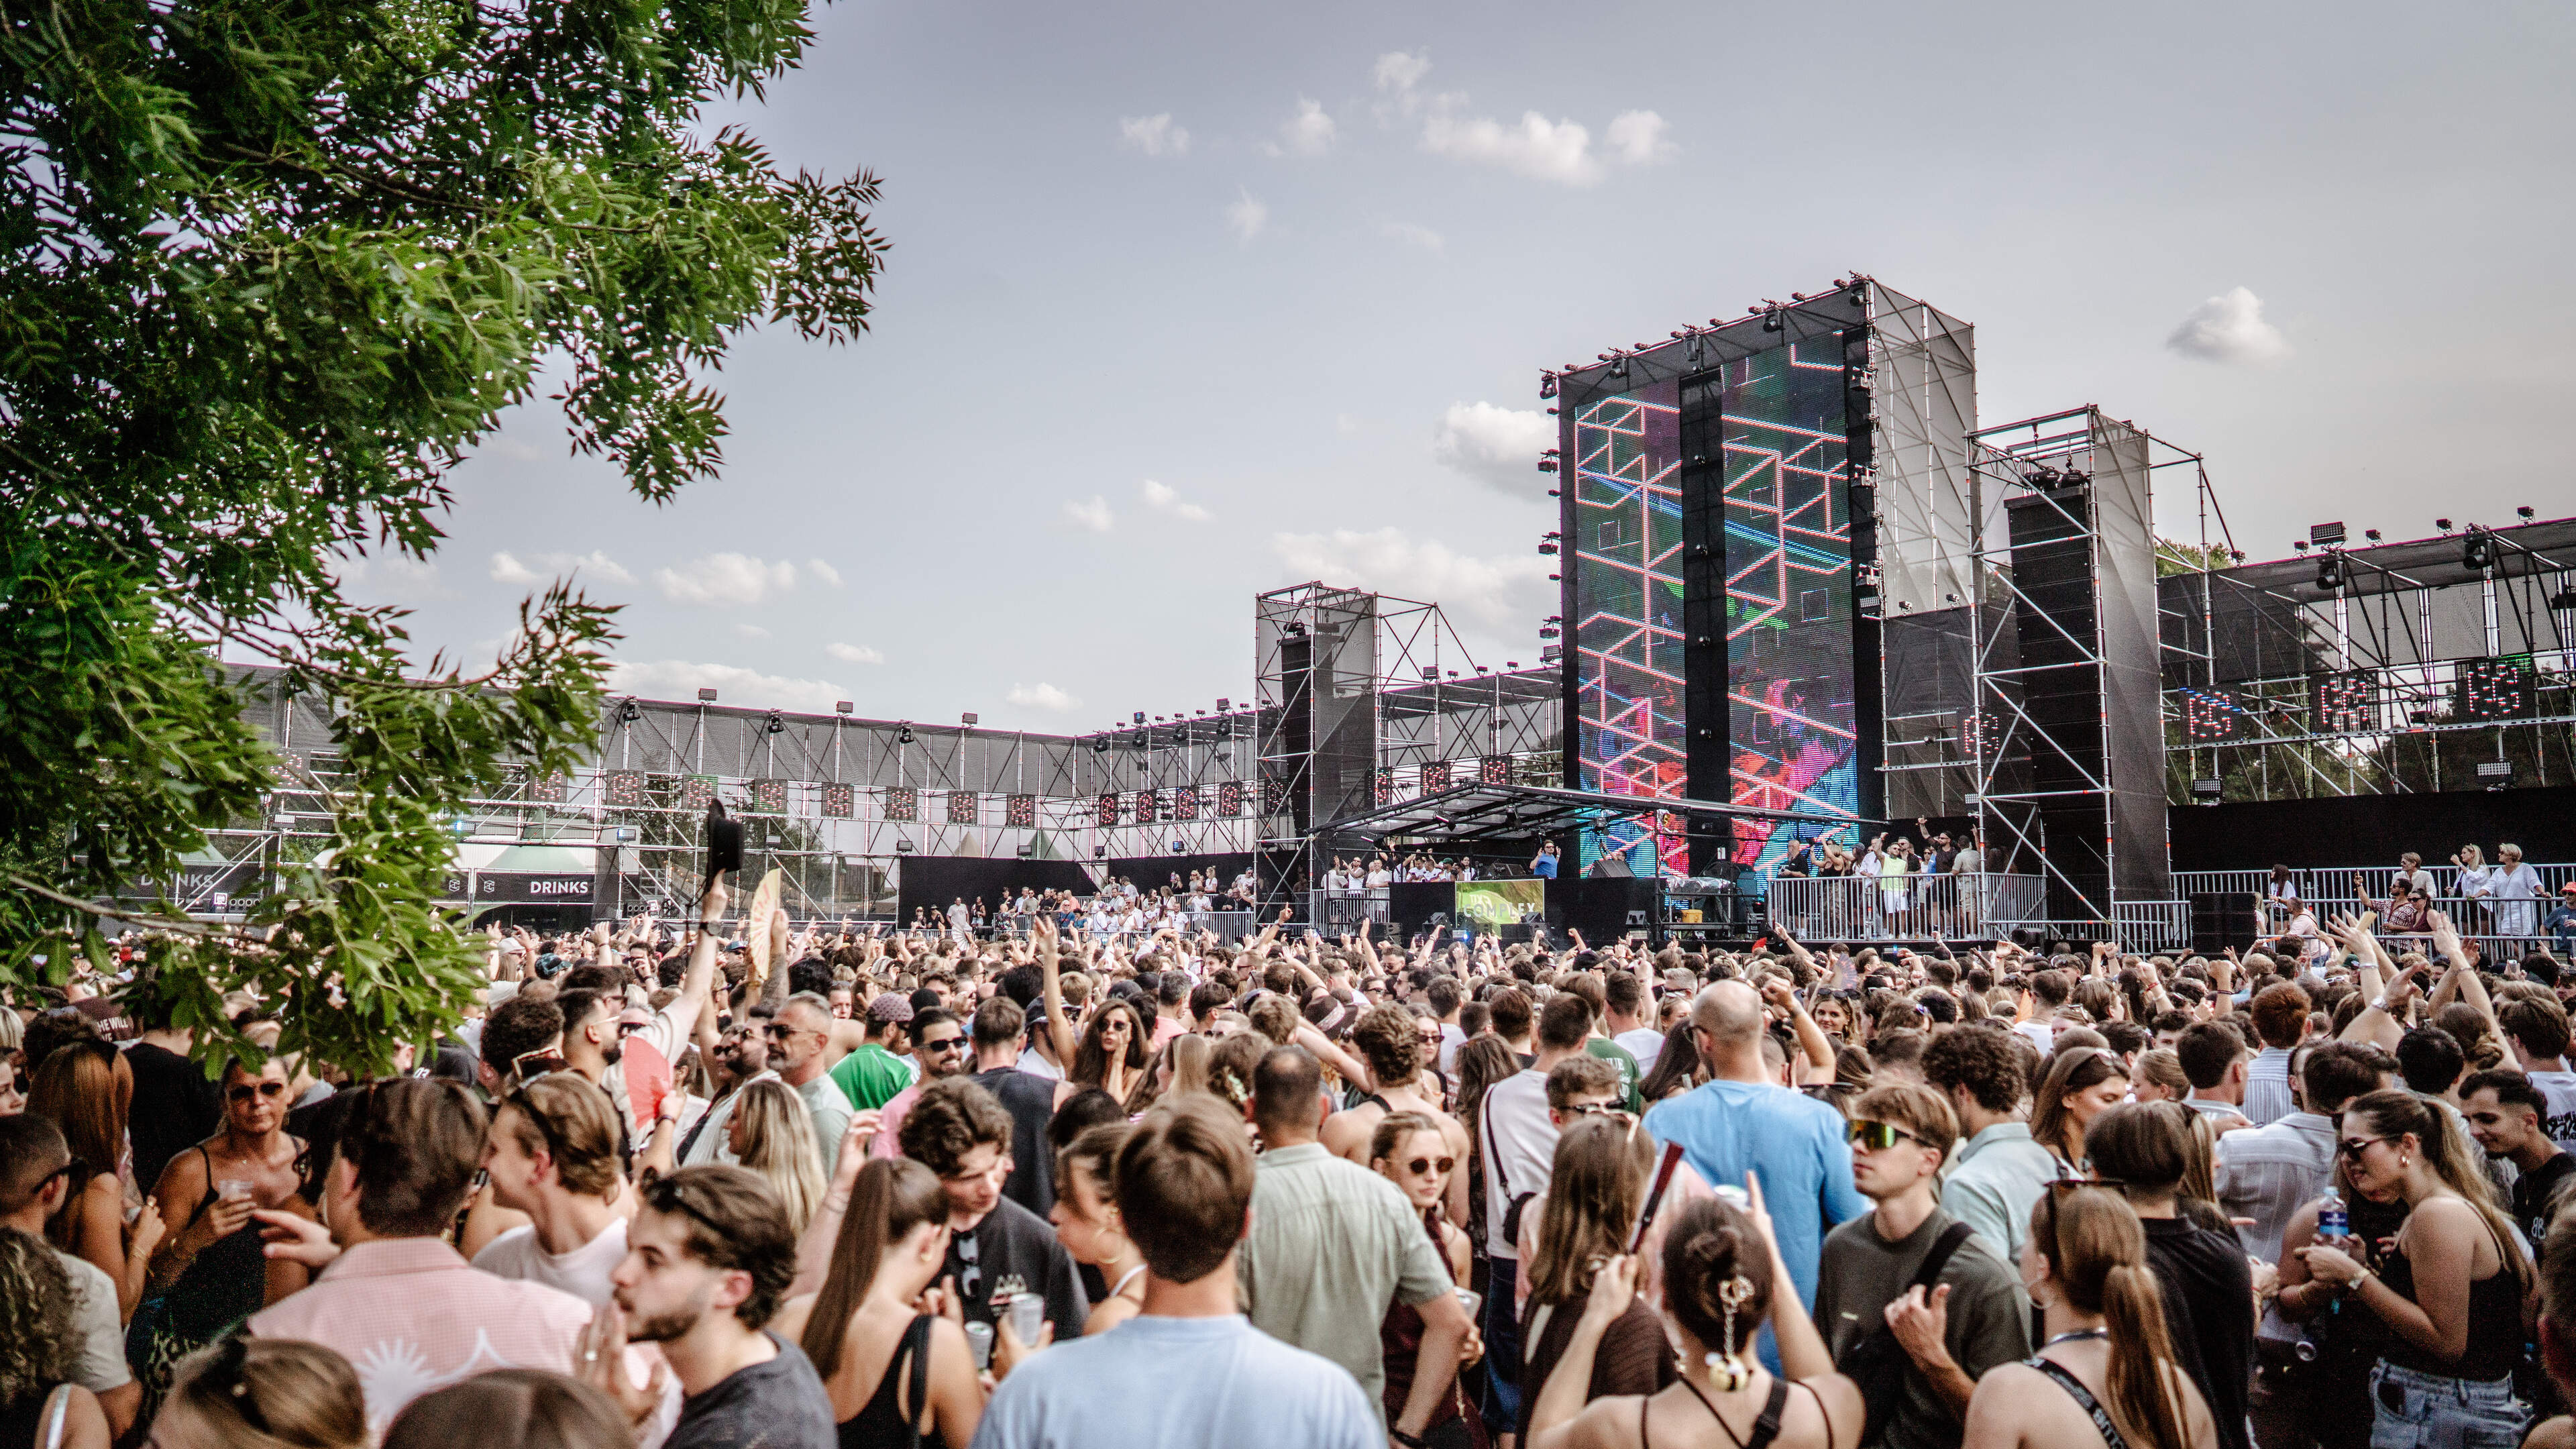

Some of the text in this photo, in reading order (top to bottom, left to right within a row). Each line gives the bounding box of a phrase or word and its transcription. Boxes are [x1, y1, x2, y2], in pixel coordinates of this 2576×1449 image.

[141, 873, 214, 887] DNKS
[531, 881, 588, 894] DRINKS
[1463, 902, 1536, 918] COMPLEX
[108, 1016, 128, 1030] WILL
